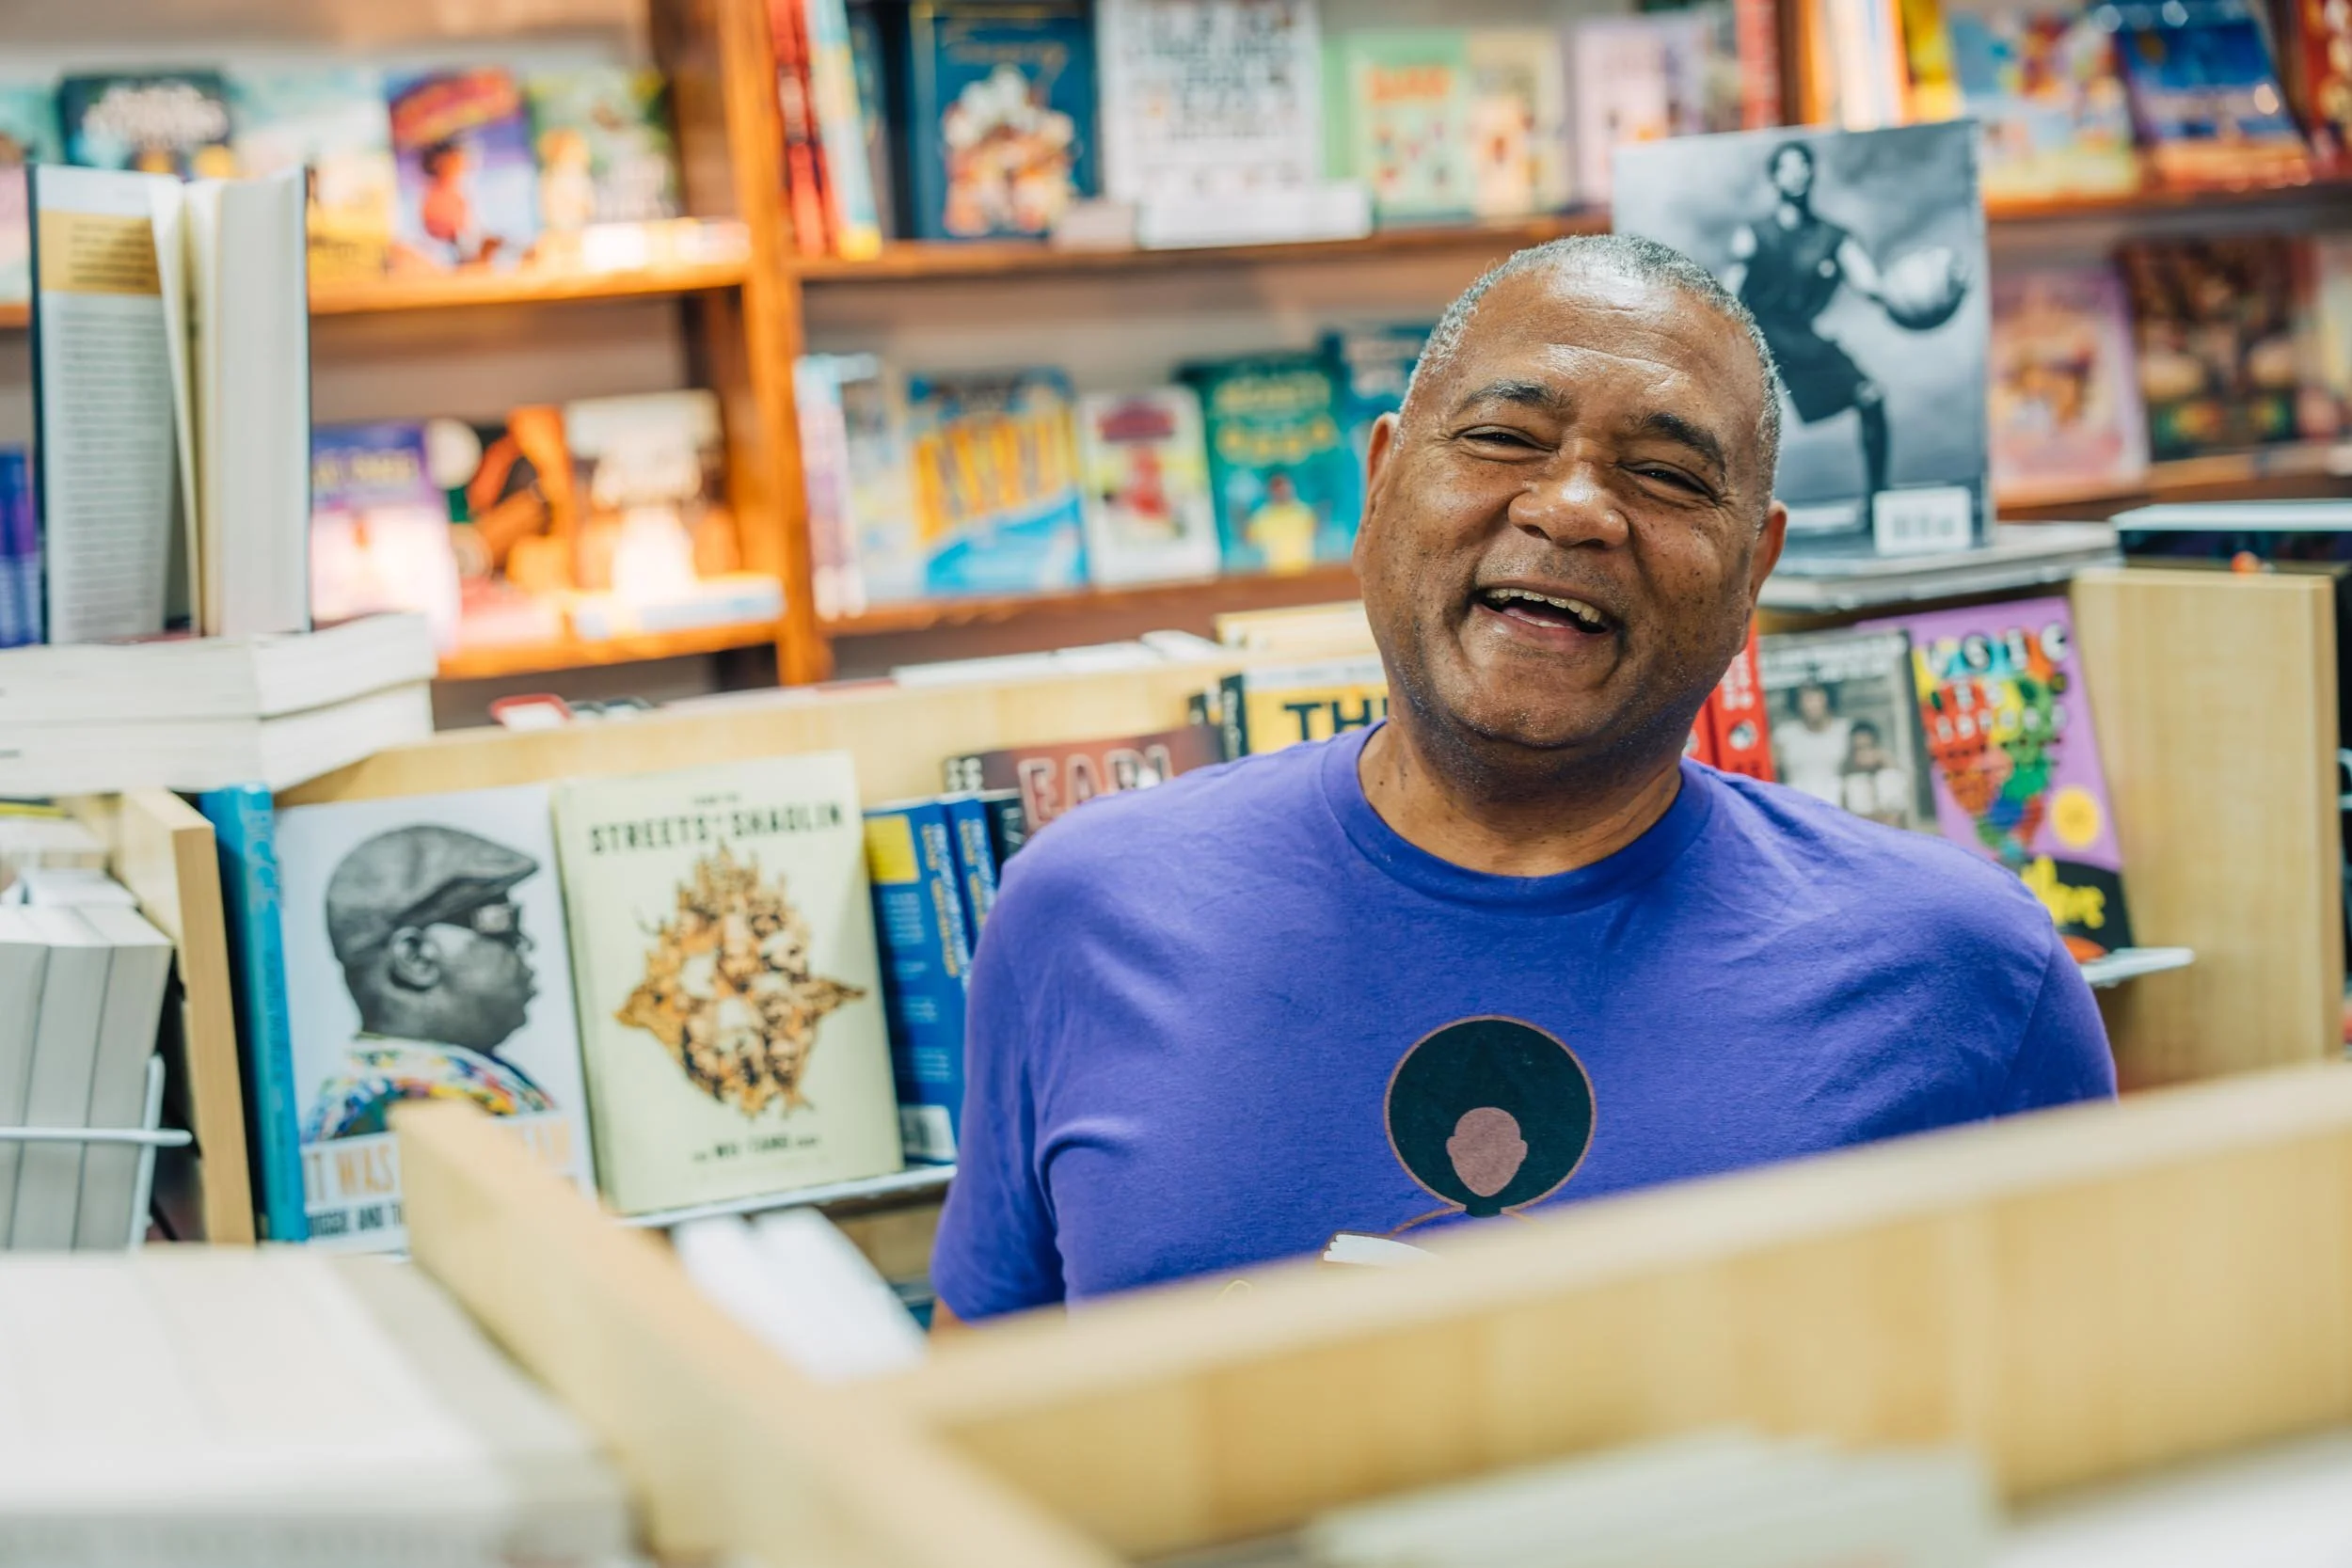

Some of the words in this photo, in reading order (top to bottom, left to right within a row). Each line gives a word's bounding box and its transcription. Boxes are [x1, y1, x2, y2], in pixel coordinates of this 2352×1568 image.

[1284, 695, 1388, 741] TH
[590, 816, 711, 854] STREETS
[731, 801, 844, 841] SHAOLIN
[334, 1142, 394, 1196] WAS
